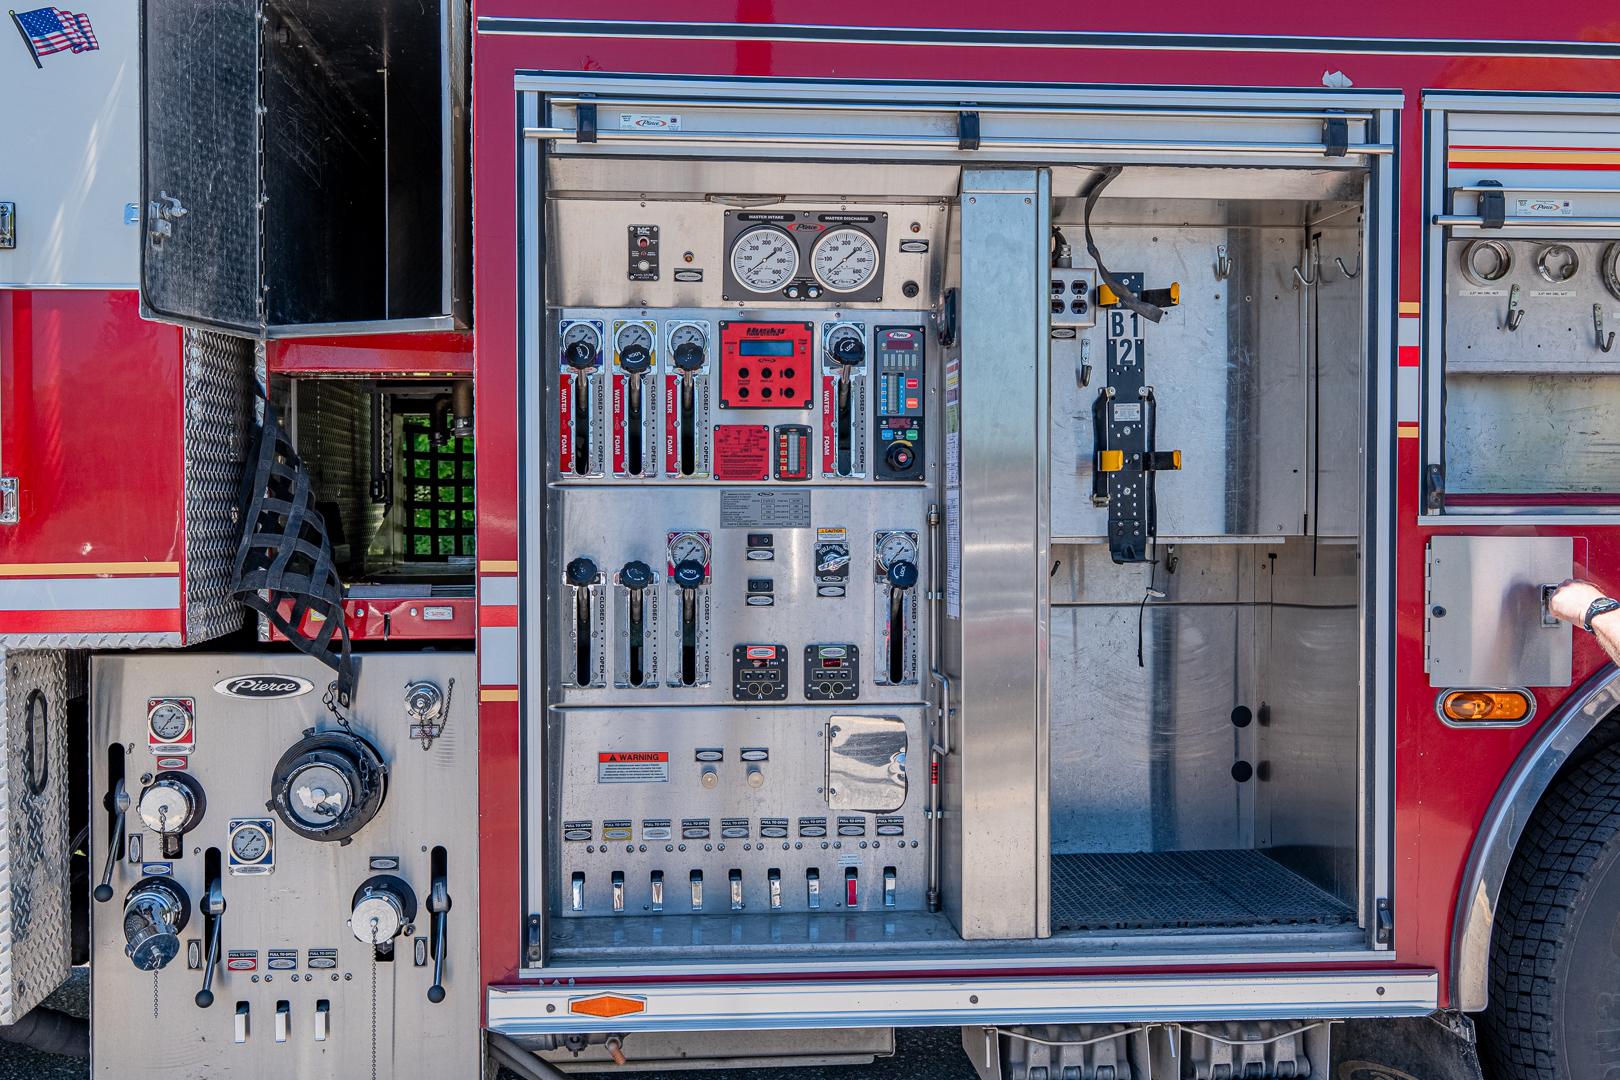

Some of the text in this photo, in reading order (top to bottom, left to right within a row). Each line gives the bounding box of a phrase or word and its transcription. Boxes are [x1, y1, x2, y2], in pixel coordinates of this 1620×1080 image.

[819, 544, 846, 555] PULL PRIME
[231, 680, 297, 693] Pierce
